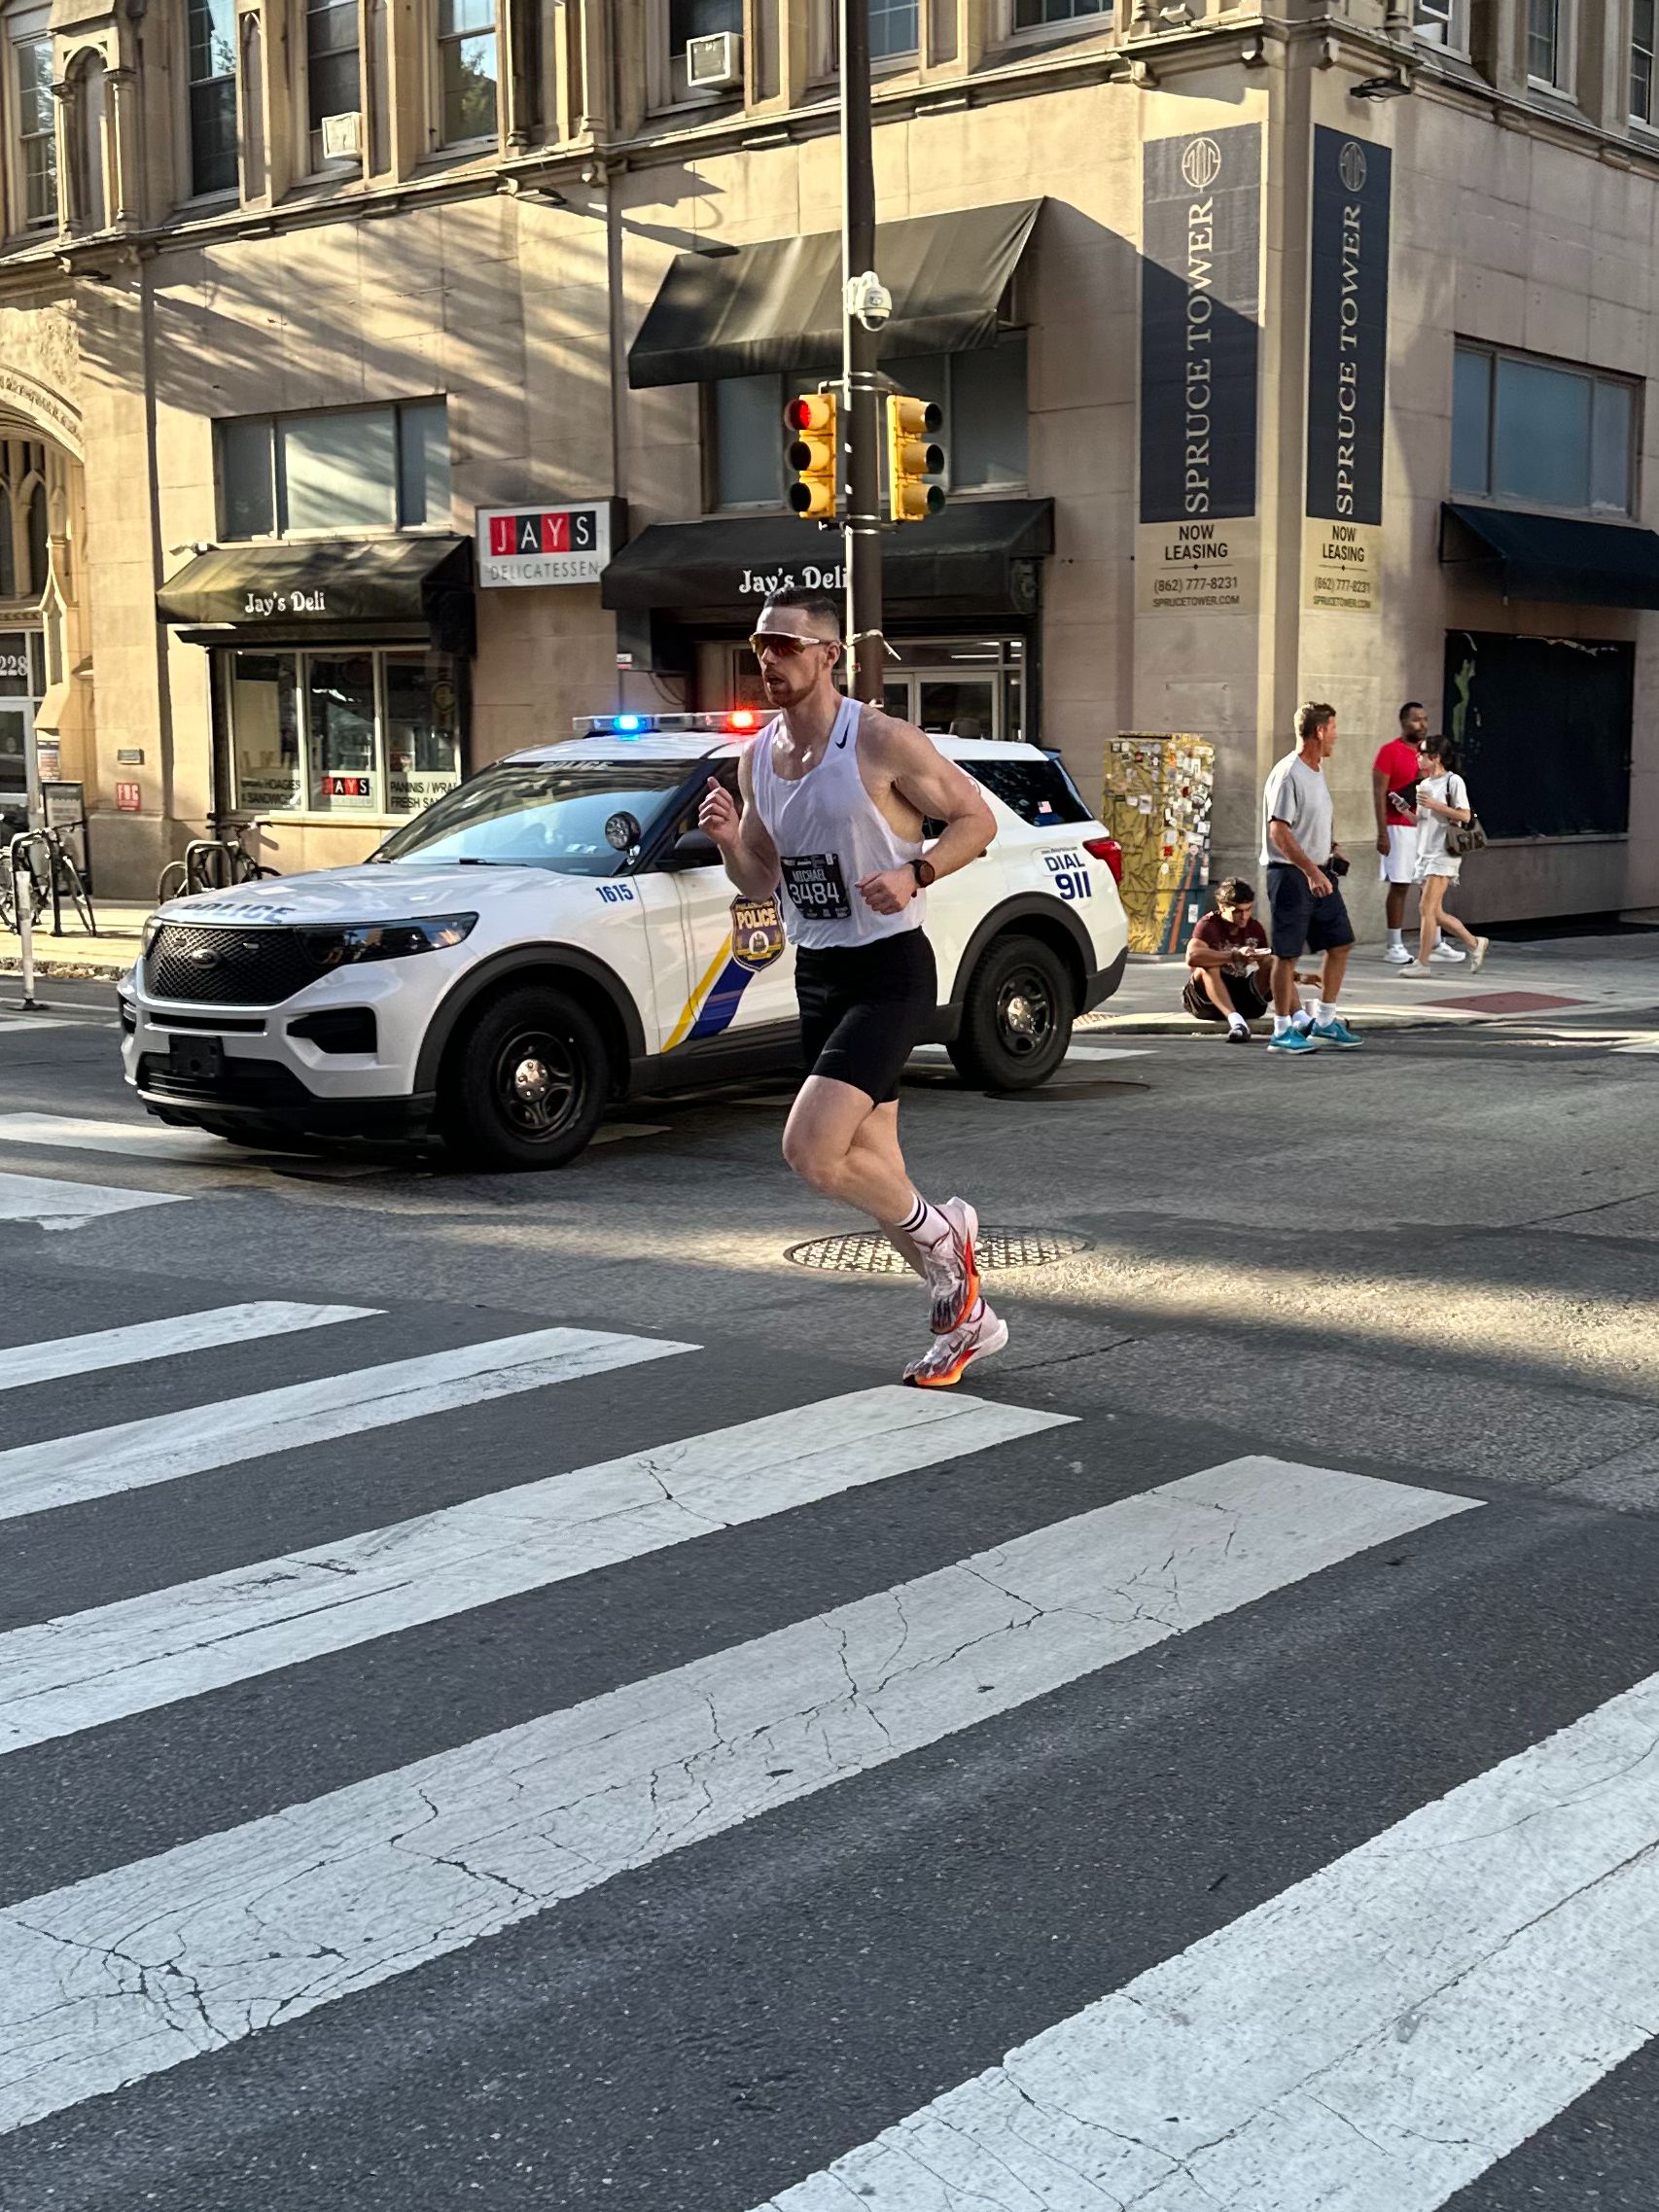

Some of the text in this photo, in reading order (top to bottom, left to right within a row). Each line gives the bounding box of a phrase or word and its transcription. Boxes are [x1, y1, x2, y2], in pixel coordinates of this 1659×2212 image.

[1184, 196, 1214, 513] SPRUCE TOWER
[1336, 203, 1361, 514] SPRUCE TOWER
[497, 515, 589, 552] JAYS
[1179, 524, 1215, 541] NOW
[1332, 525, 1357, 542] NOW
[1164, 543, 1228, 561] LEASING
[1323, 544, 1365, 562] LEASING
[490, 561, 599, 580] DELICATESSEN
[739, 564, 848, 596] Jay's Deli
[1154, 576, 1238, 594] (862) 777-8231
[244, 589, 327, 616] Jay's Deli
[390, 796, 420, 809] FRESH
[1044, 853, 1086, 872] DIAL
[595, 884, 634, 903] 1615
[789, 882, 840, 905] 3484
[1055, 870, 1092, 900] 911
[182, 902, 297, 924] POLICE
[736, 907, 778, 930] POLICE
